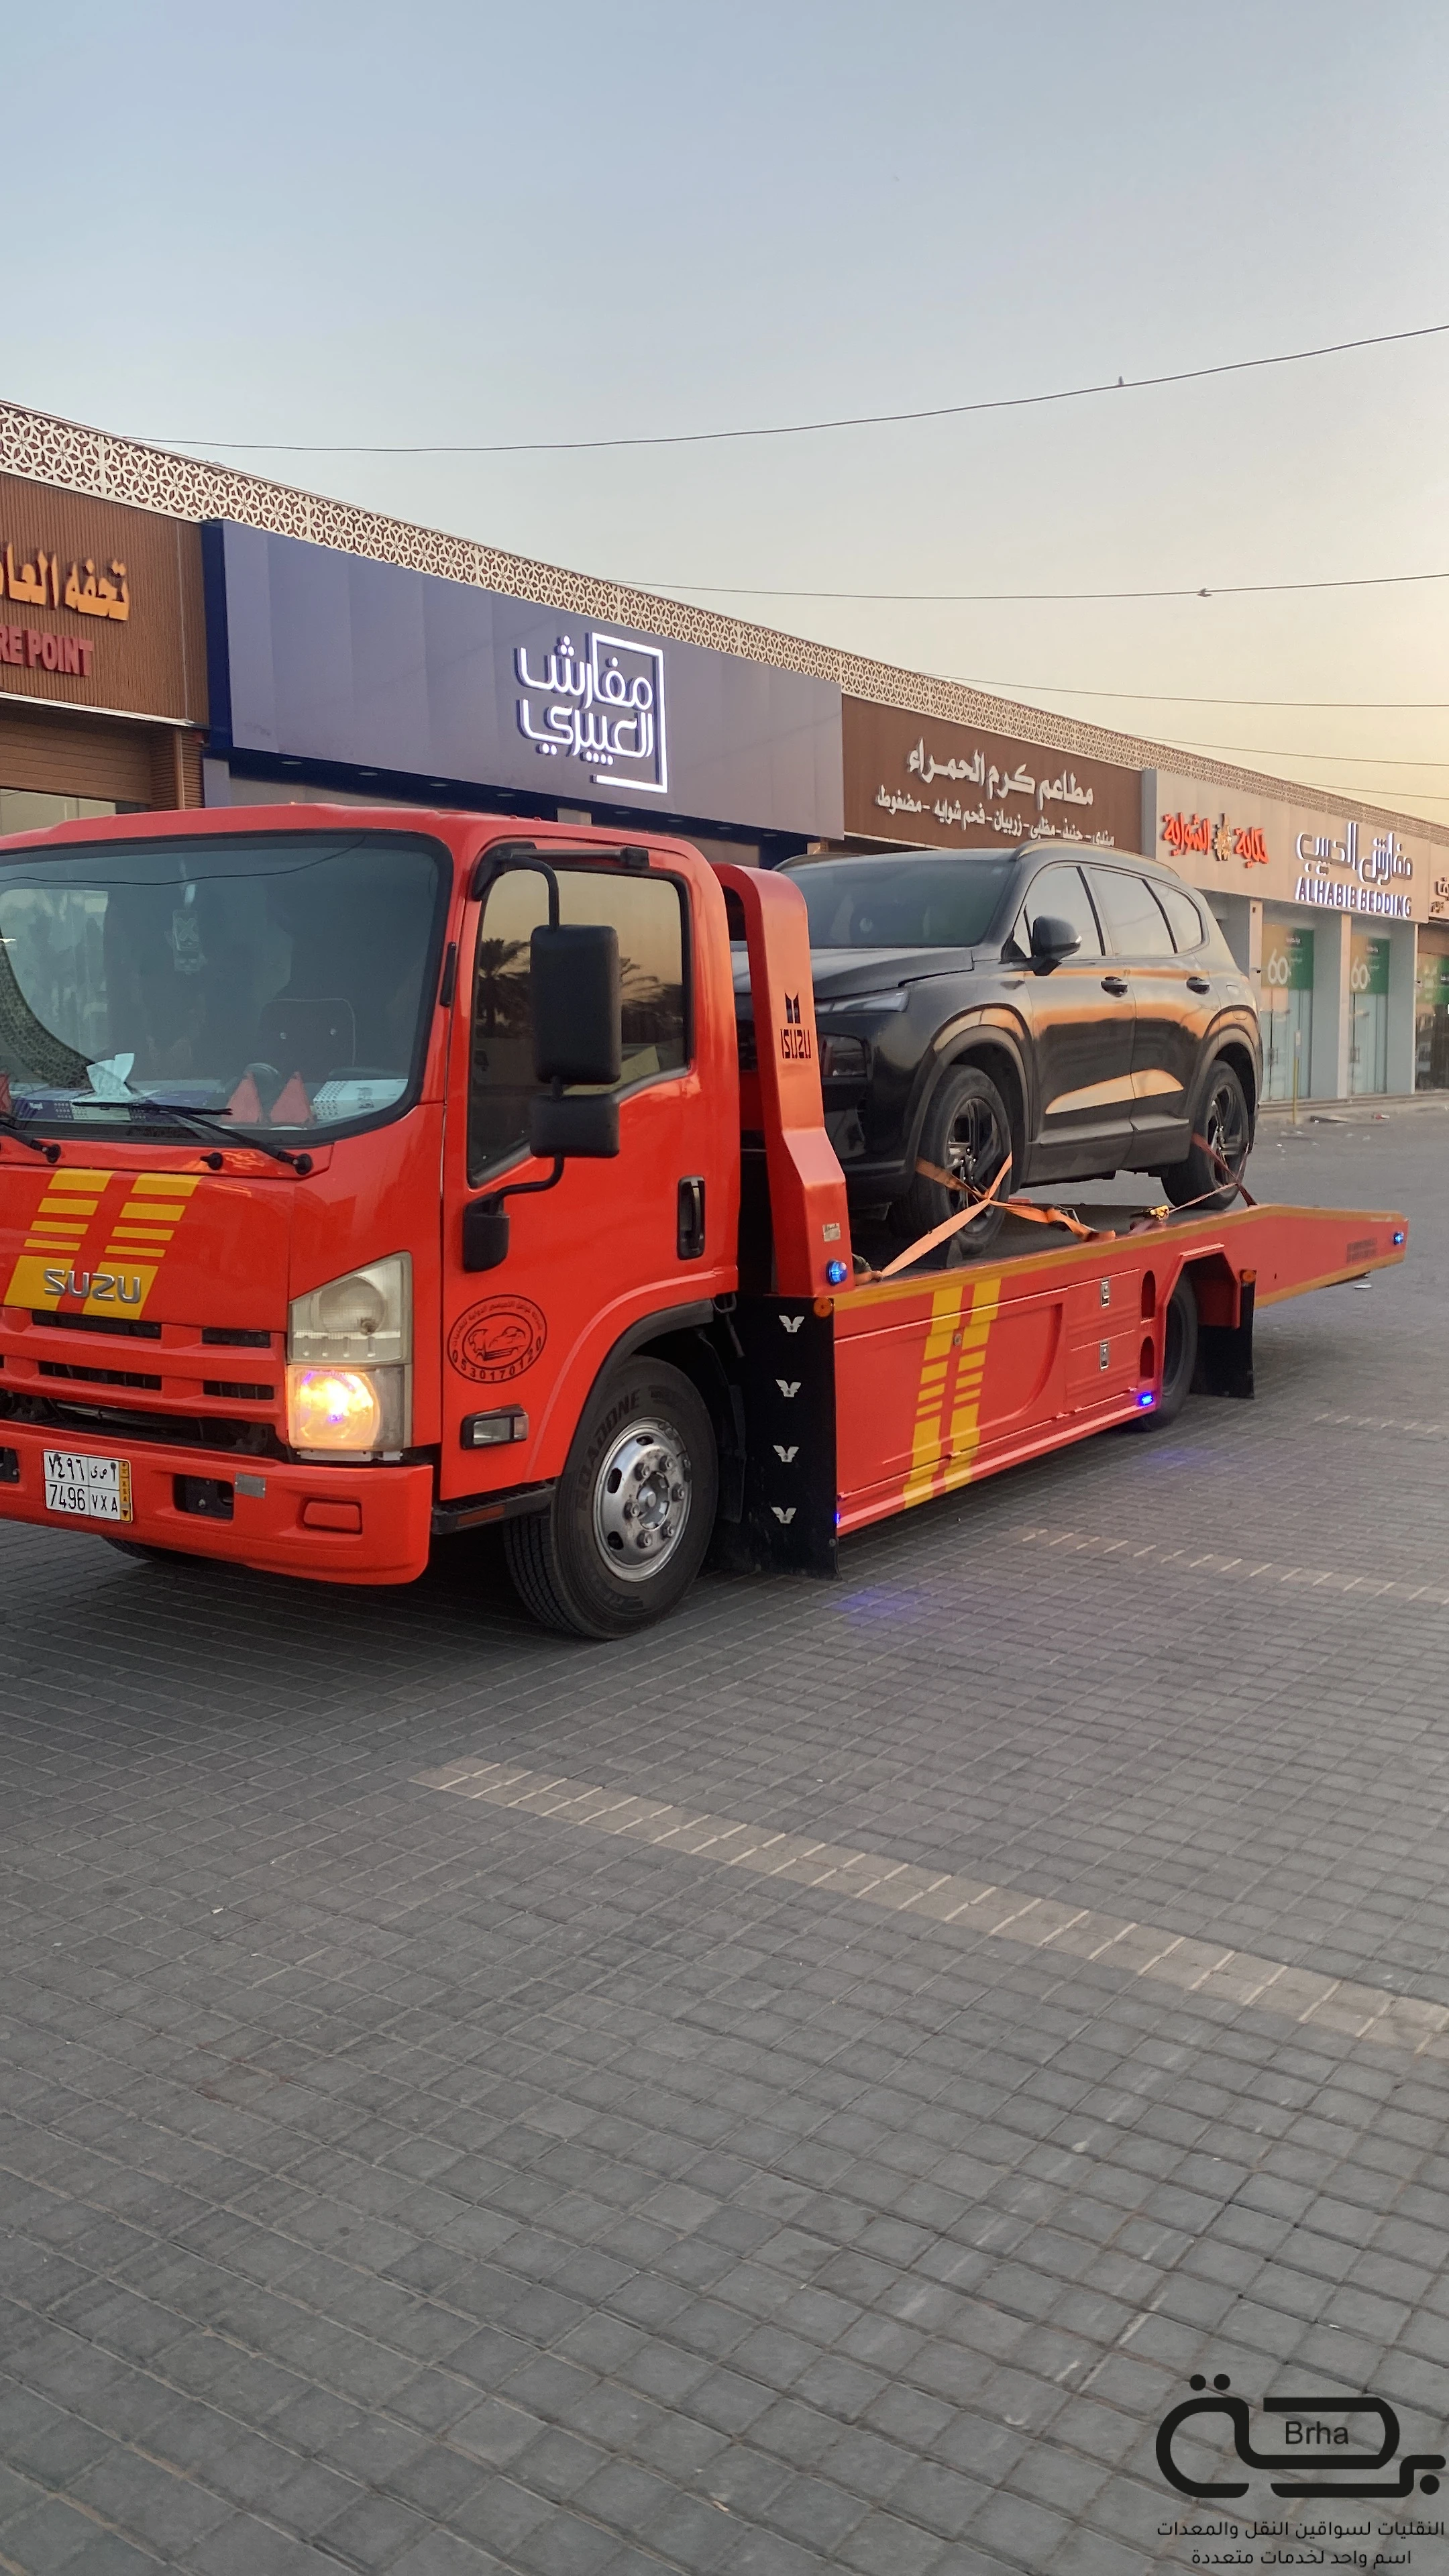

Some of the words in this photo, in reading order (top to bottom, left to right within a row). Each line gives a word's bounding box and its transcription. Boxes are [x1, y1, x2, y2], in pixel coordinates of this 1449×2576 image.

[0, 541, 59, 607] العا
[27, 629, 94, 677] POINT
[515, 632, 654, 711] مفارش
[909, 737, 985, 786] الحمراء
[988, 763, 1036, 800] كرم
[1038, 769, 1093, 811] مطاعم
[1295, 822, 1358, 875] الحبيب
[1358, 833, 1413, 892] مفارش
[1357, 888, 1412, 918] BEDDING
[780, 1028, 811, 1059] ISUZU
[43, 1268, 141, 1303] SUZU
[49, 1483, 86, 1511] 7496
